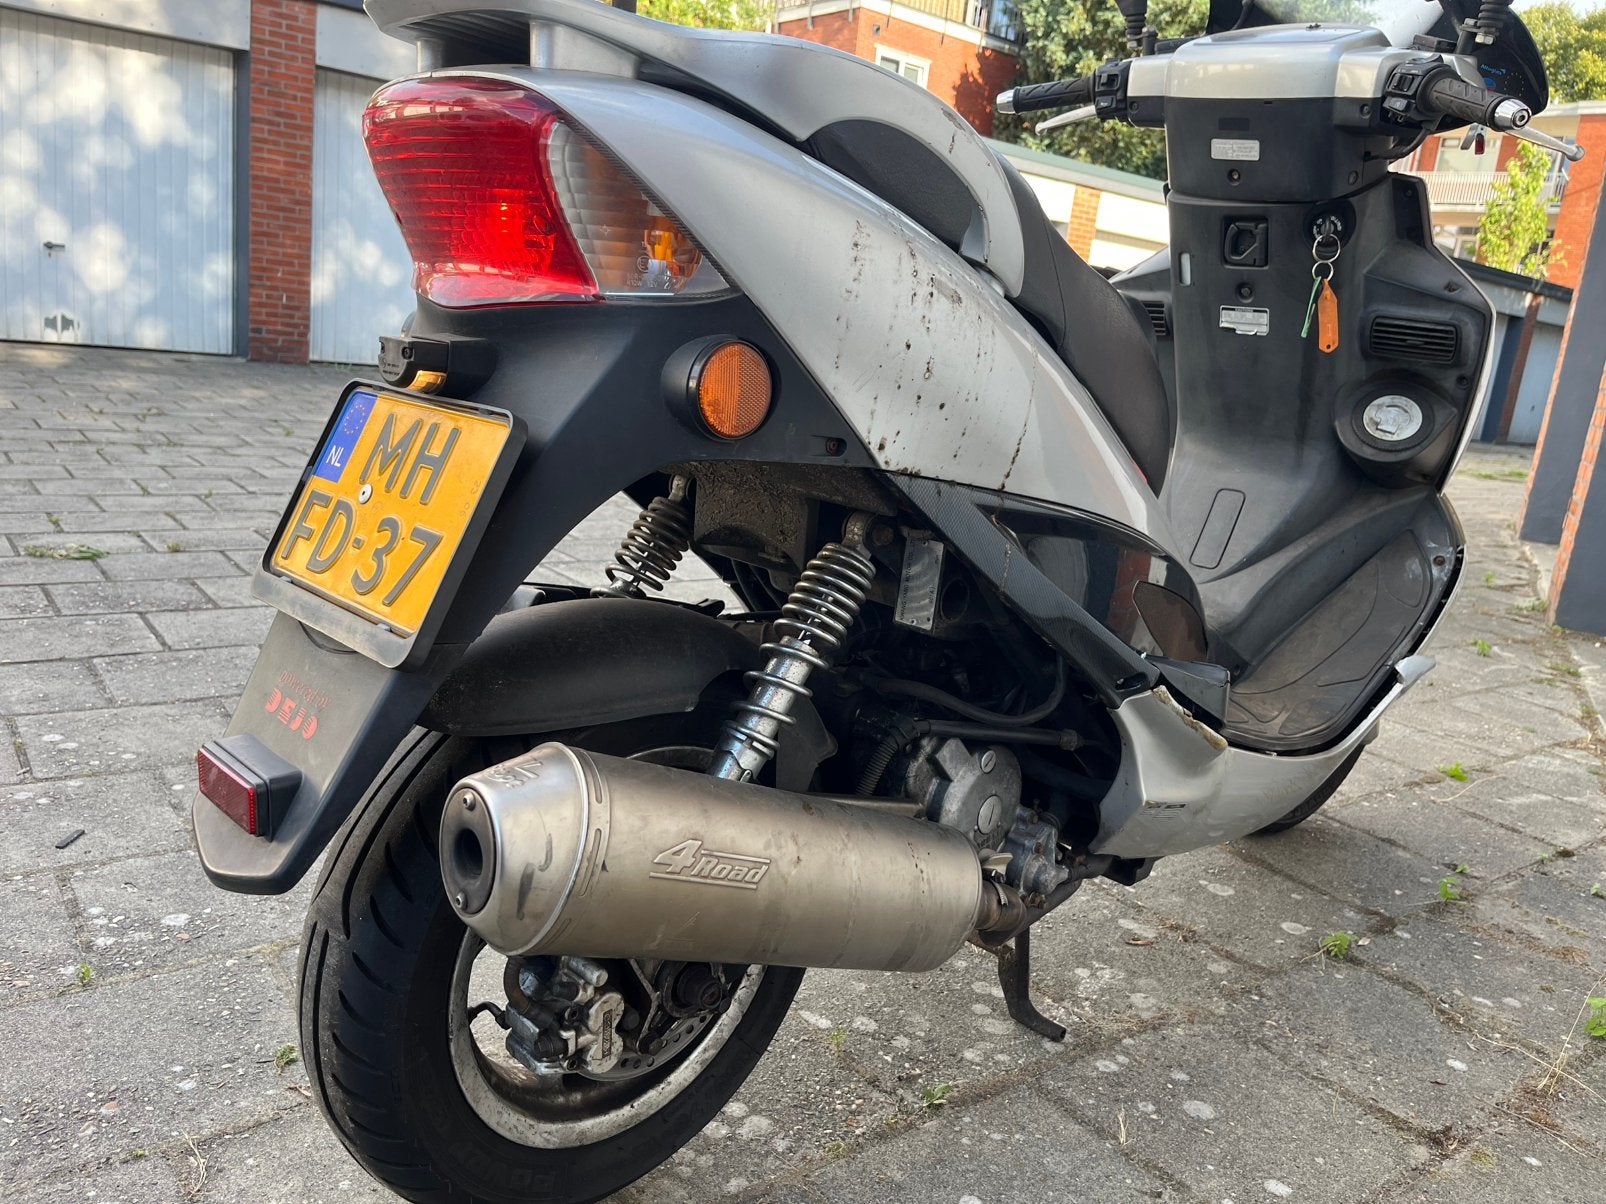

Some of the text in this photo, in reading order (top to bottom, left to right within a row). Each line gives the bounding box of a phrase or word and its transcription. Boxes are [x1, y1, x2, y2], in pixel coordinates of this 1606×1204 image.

[325, 445, 341, 468] NL
[359, 413, 462, 505] MH
[281, 489, 445, 607] FD-37
